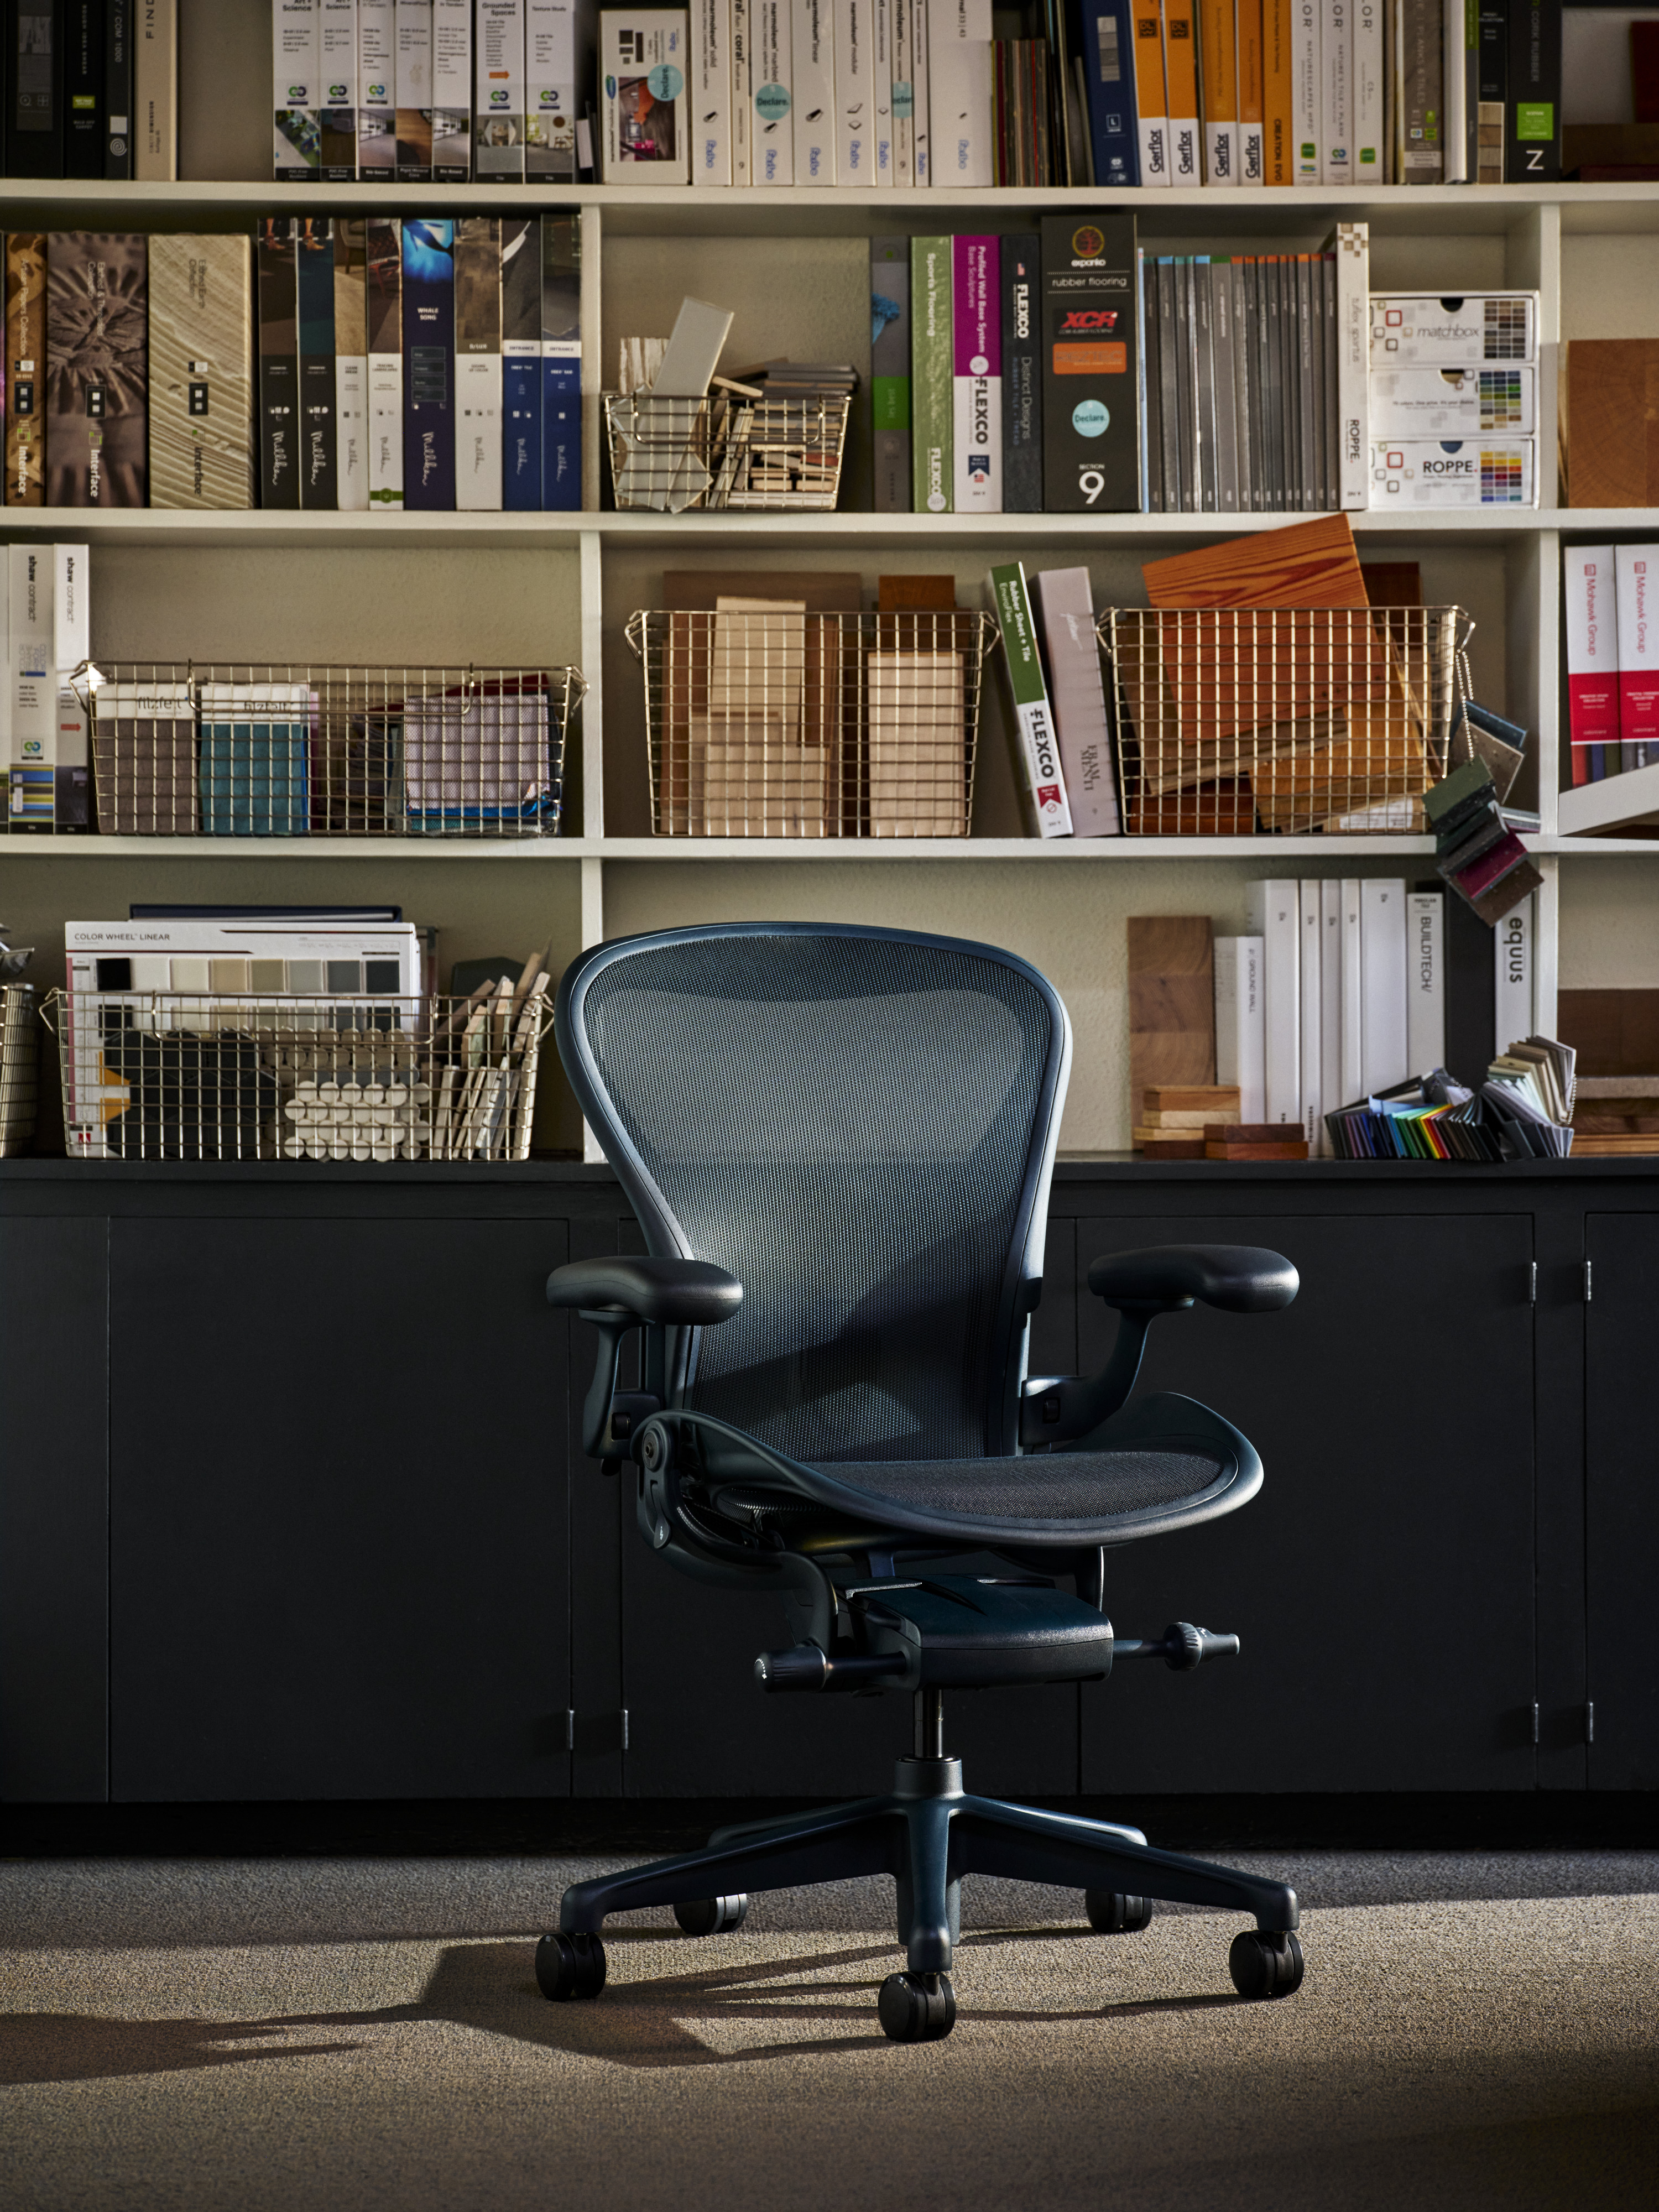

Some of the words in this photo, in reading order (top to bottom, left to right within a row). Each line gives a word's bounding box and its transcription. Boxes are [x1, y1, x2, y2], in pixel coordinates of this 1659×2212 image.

[896, 0, 905, 40] rmoleum
[1302, 0, 1313, 27] OR
[1333, 0, 1343, 27] OR
[1362, 0, 1373, 28] OR
[735, 34, 745, 60] coral
[757, 97, 789, 106] Declare.
[1148, 130, 1162, 173] Gerflor
[1177, 131, 1191, 174] Gerflor
[1214, 134, 1228, 178] Gerflor
[1244, 136, 1259, 179] Gerflor
[1526, 149, 1544, 170] Z
[927, 253, 937, 289] Sports
[978, 246, 987, 279] Profiled
[1052, 278, 1085, 286] rubber
[1088, 276, 1127, 287] flooring
[1071, 258, 1106, 268] expanko
[978, 280, 987, 299] Wall
[927, 291, 937, 337] Flooring
[978, 301, 987, 321] Base
[1017, 284, 1029, 338] FLEXCO
[20, 316, 29, 356] Collection
[976, 322, 987, 353] System
[1417, 324, 1479, 338] matchbox
[1021, 357, 1032, 395] Distinct
[975, 378, 988, 444] FLEXCO
[1019, 397, 1032, 440] Designs
[1074, 414, 1105, 422] Declare.
[18, 446, 28, 493] Interface
[90, 449, 100, 497] Interface
[194, 447, 204, 494] Interface
[272, 431, 288, 486] Milliken
[310, 431, 327, 485] Milliken
[421, 431, 437, 486] Milliken
[931, 447, 941, 495] FLEXCO
[1079, 471, 1105, 504] 9
[999, 582, 1013, 623] EnviroFlex
[1009, 580, 1021, 609] Rubber
[1587, 578, 1596, 622] Mohawk
[1636, 576, 1646, 620] Mohawk
[1014, 612, 1027, 637] Sheet
[1588, 624, 1598, 656] Group
[1637, 622, 1647, 654] Group
[1021, 645, 1031, 662] Tile
[138, 696, 181, 709] filzfet
[1031, 708, 1055, 778] FLEXCO
[1503, 917, 1523, 983] equus
